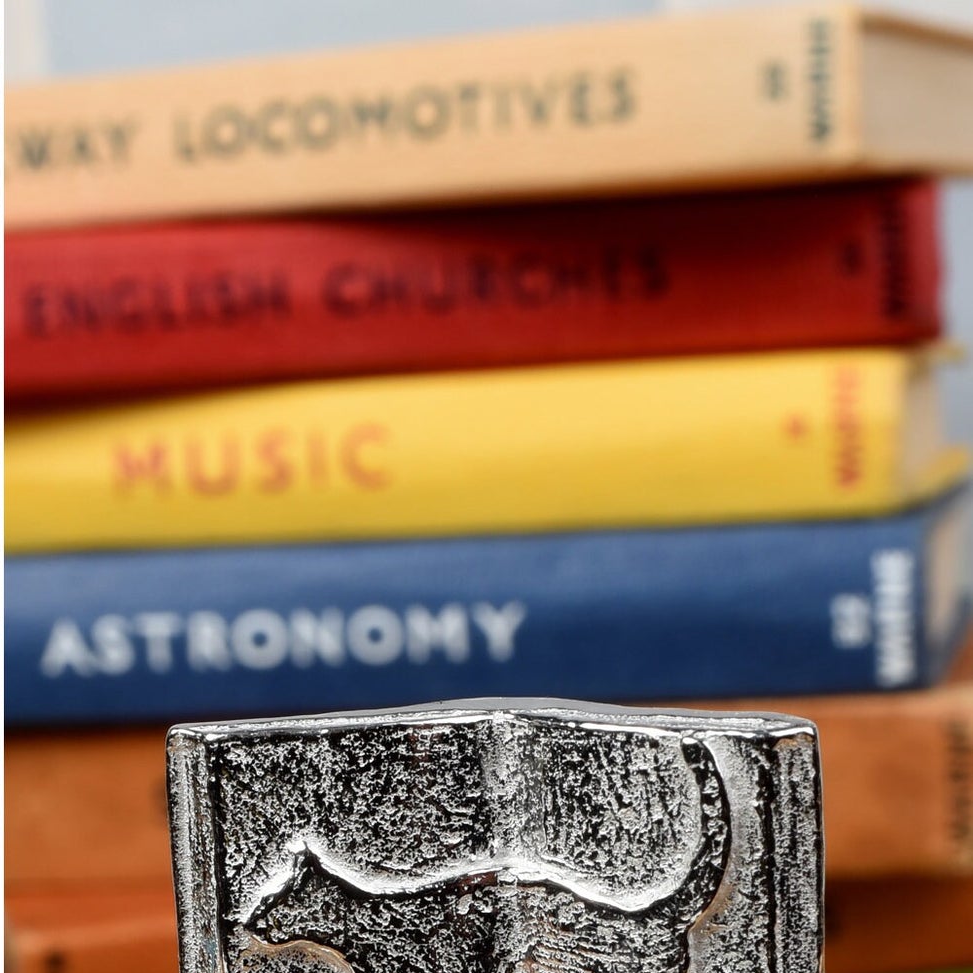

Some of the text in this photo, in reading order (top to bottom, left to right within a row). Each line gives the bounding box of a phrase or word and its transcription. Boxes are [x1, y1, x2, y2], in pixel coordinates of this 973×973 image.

[172, 68, 639, 165] LOCOMOTIVES
[27, 246, 671, 340] ENGLISH CHURCHES
[111, 424, 395, 500] MUSIC
[39, 603, 527, 678] ASTRONOMY
